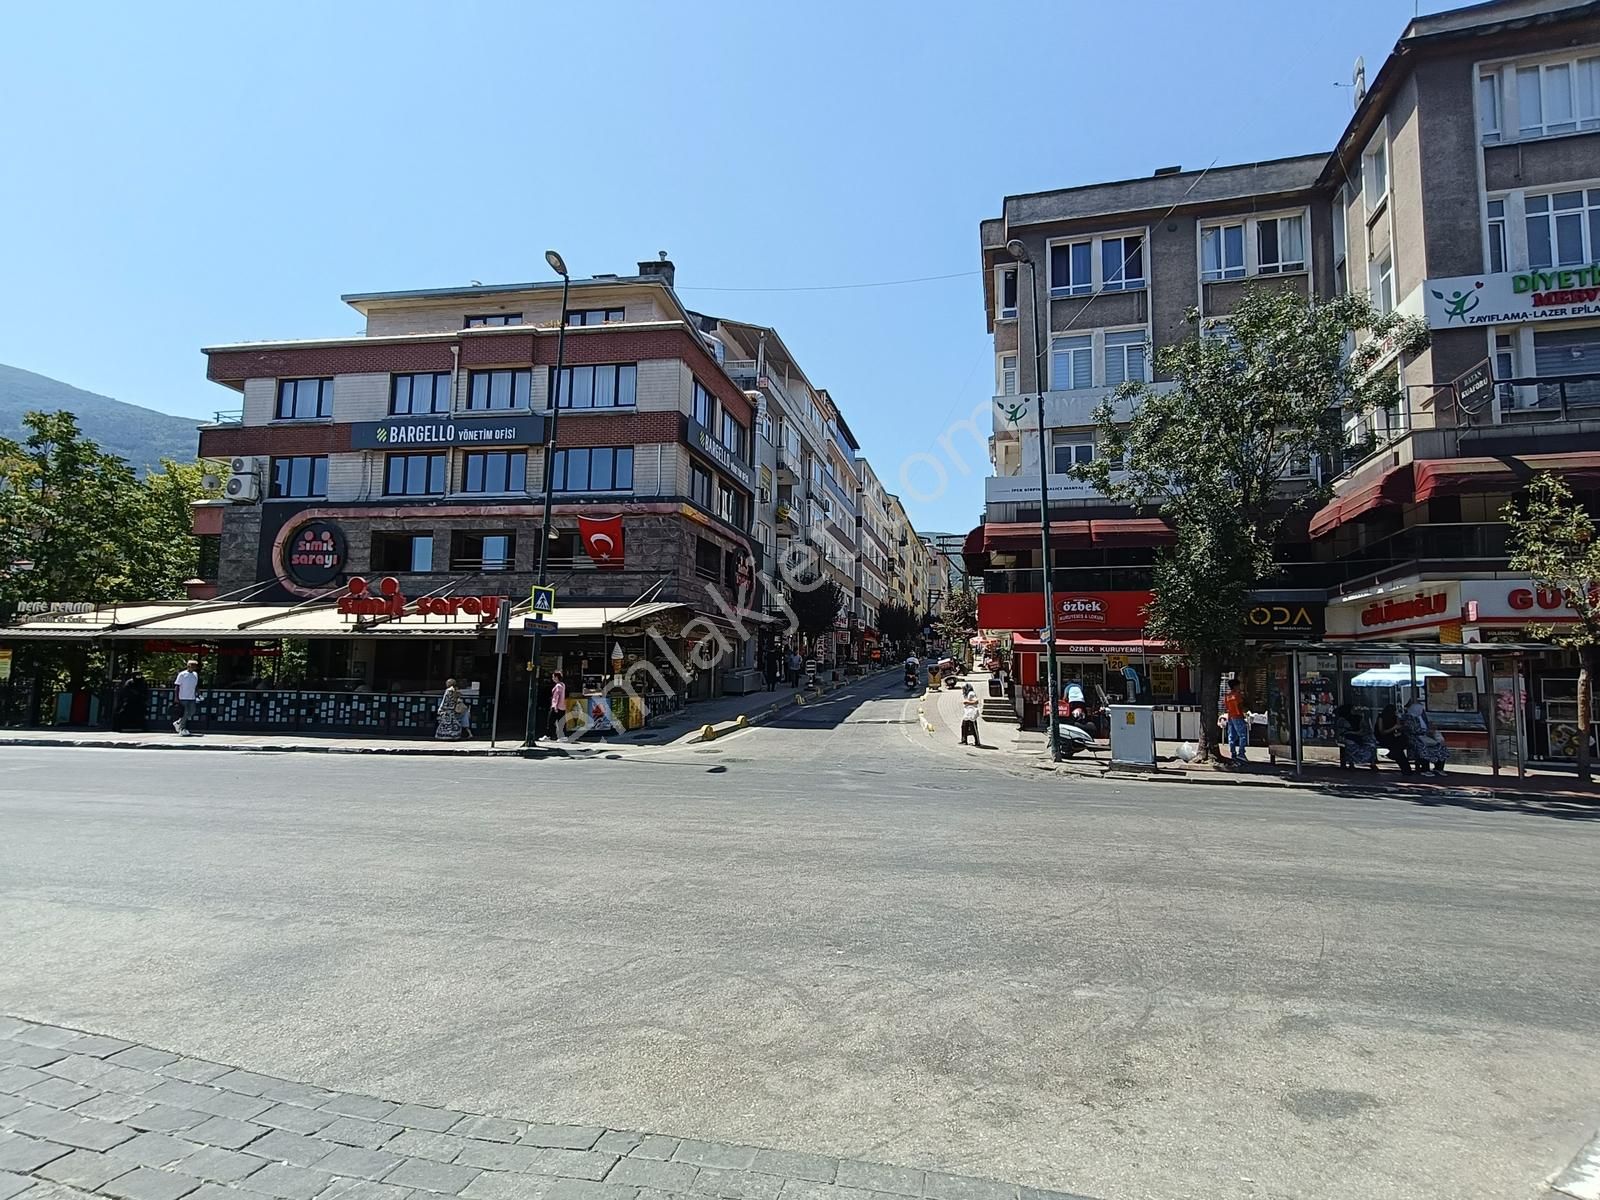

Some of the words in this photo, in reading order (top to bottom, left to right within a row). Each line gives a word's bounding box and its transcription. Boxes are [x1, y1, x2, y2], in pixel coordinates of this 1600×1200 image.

[1469, 307, 1567, 324] ZAYIFLAMA-LAZER
[389, 424, 454, 443] BARGELLO
[458, 428, 493, 441] YÖNETİM
[494, 427, 516, 440] OFİSİ
[705, 434, 730, 468] BARGELLO
[298, 531, 335, 551] simit
[291, 554, 338, 568] sarayı
[416, 595, 511, 624] saray
[1063, 601, 1102, 612] özbek
[1241, 607, 1312, 625] ODA
[1100, 645, 1143, 653] KURUYEMİŞ
